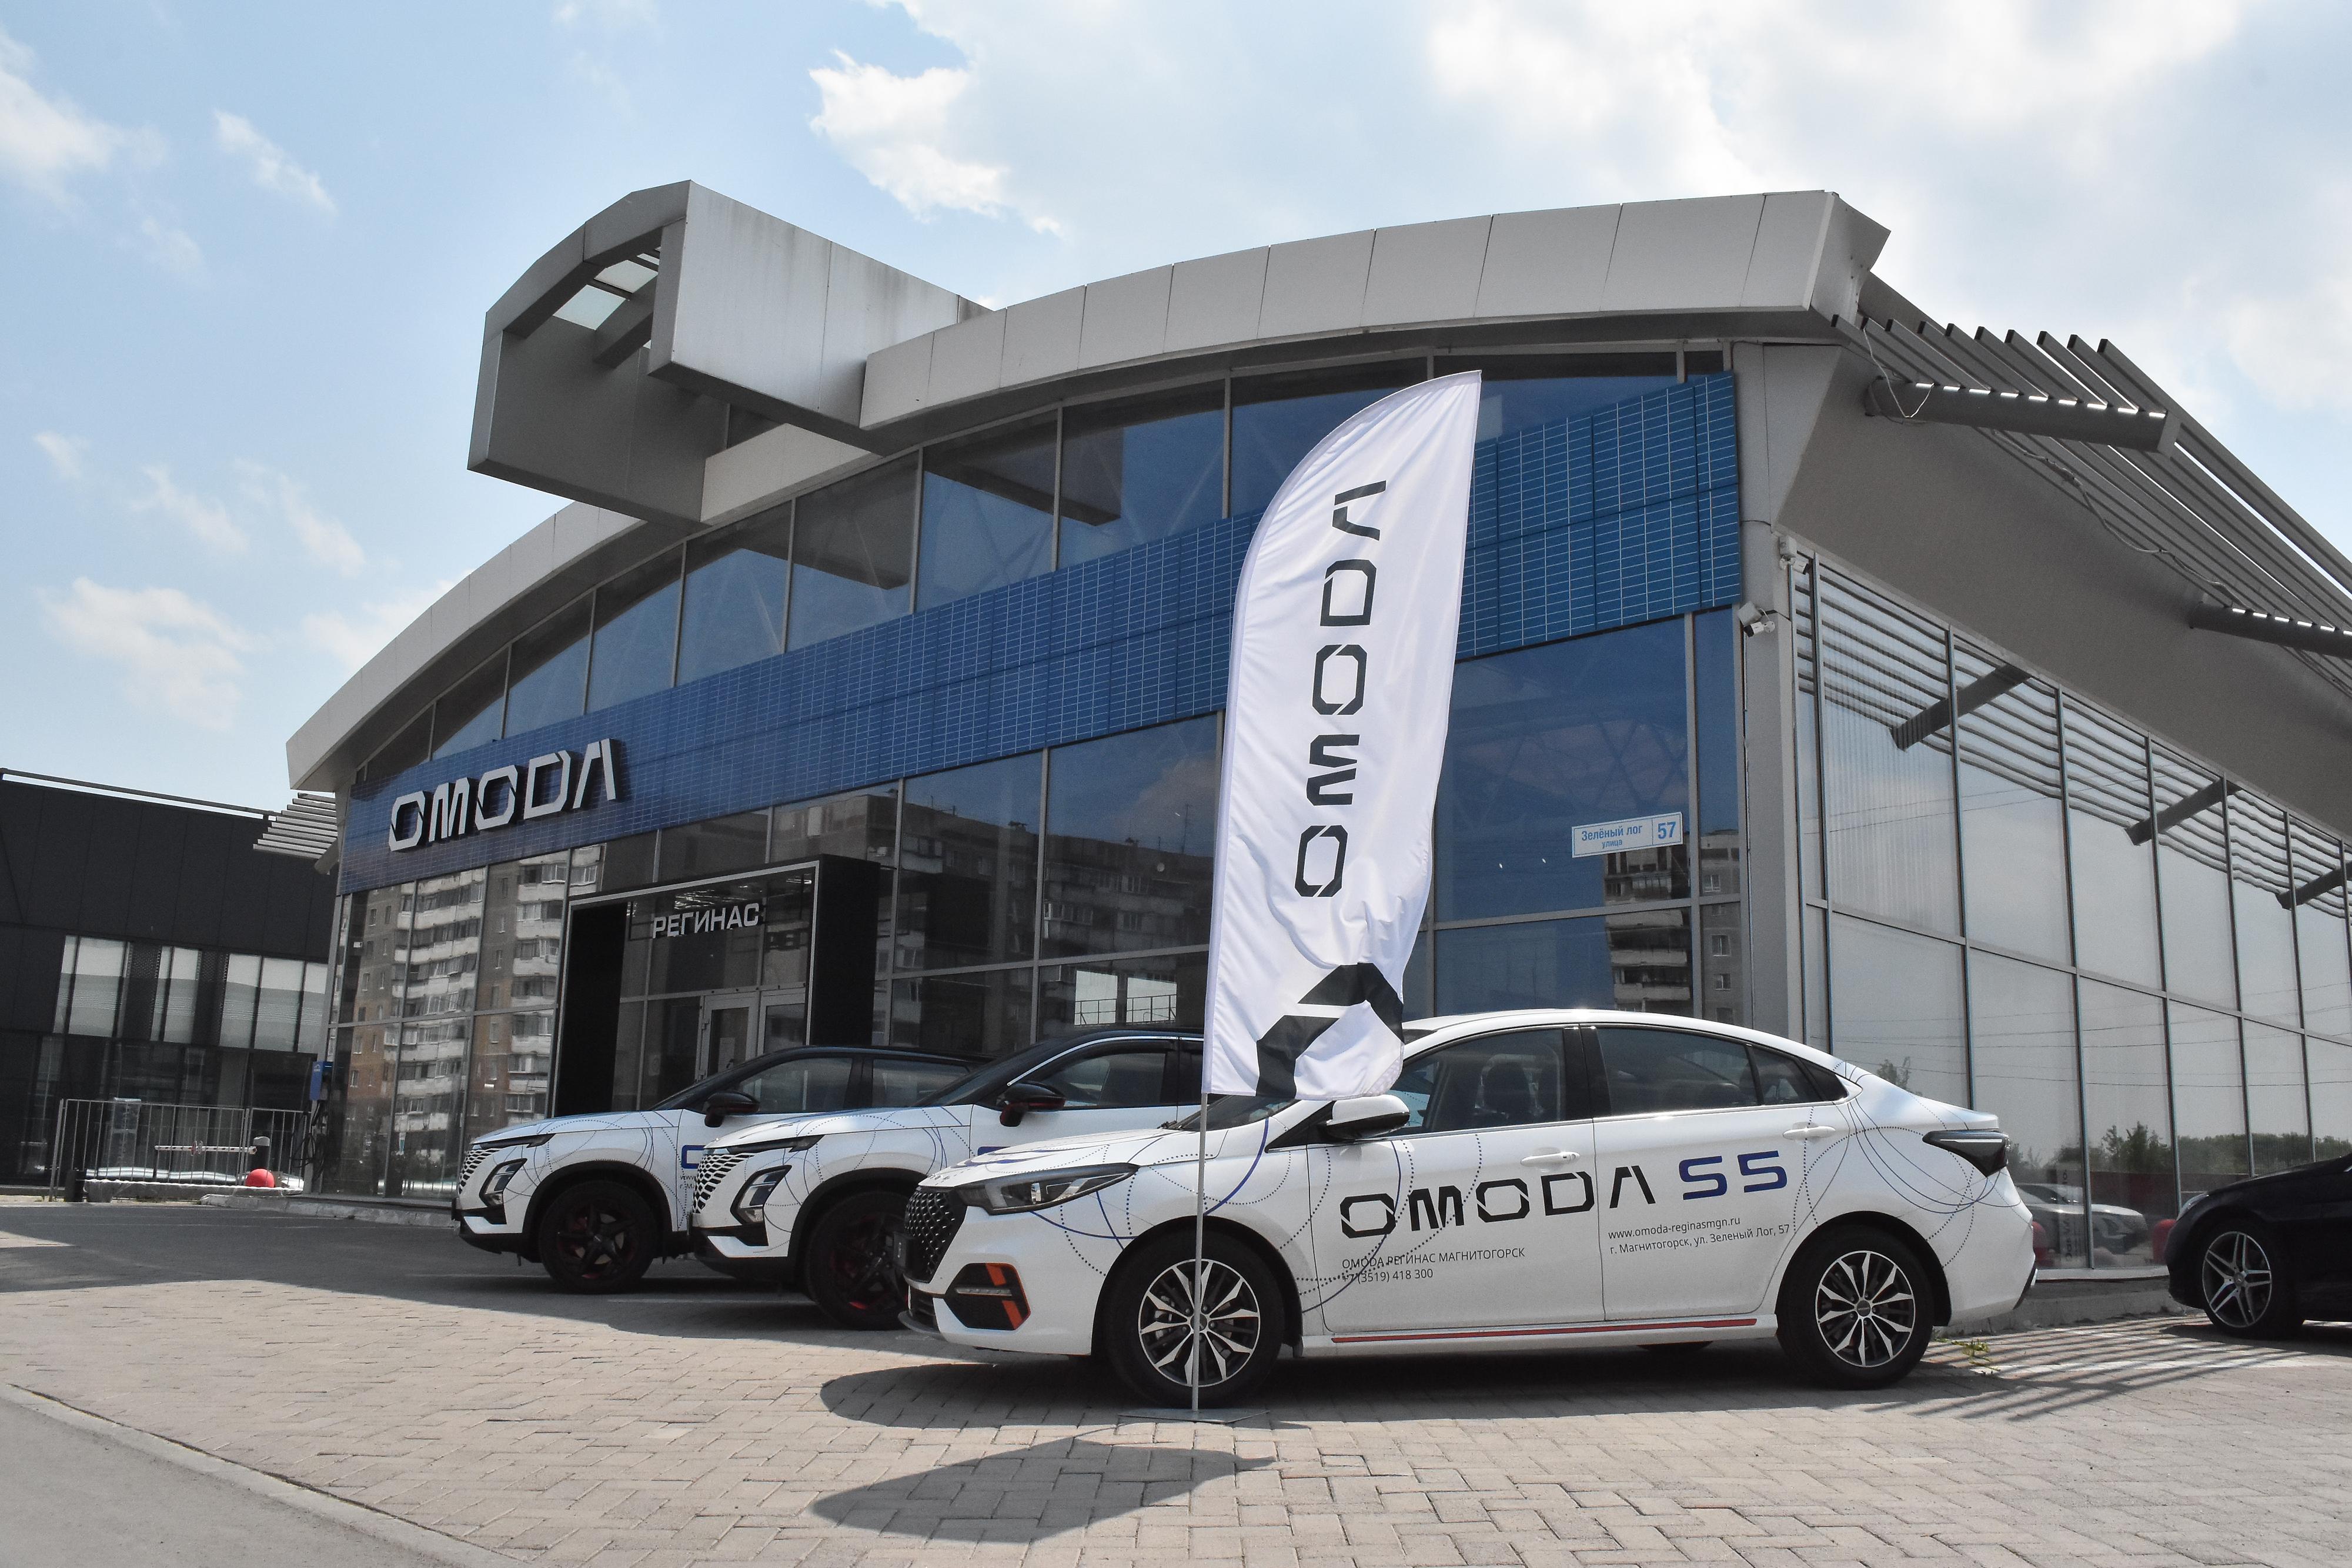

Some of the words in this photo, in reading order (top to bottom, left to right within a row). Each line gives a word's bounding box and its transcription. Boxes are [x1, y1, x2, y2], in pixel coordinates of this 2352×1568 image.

[1294, 480, 1387, 898] OMODA
[388, 738, 617, 852] OMODA
[1581, 825, 1624, 841] Зелёный
[1626, 825, 1643, 835] лог
[1657, 821, 1676, 840] 57
[1602, 839, 1623, 849] улица
[652, 902, 760, 939] РЕГИНАС
[1339, 1165, 1656, 1239] OMODA
[1678, 1150, 1788, 1201] S5
[1608, 1216, 1740, 1240] www.omoda-reginasmgn.ru
[1619, 1237, 1692, 1253] Магнитогорск,
[1693, 1236, 1708, 1247] ул.
[1710, 1228, 1754, 1243] Зеленый
[1756, 1227, 1776, 1238] Лог,
[1778, 1223, 1790, 1235] 57
[1387, 1253, 1436, 1265] РЕГИНАС
[1439, 1248, 1525, 1262] МАГНИТОГОРСК
[1357, 1271, 1390, 1285] (3519)
[1392, 1270, 1412, 1281] 418
[1414, 1268, 1434, 1279] 300
